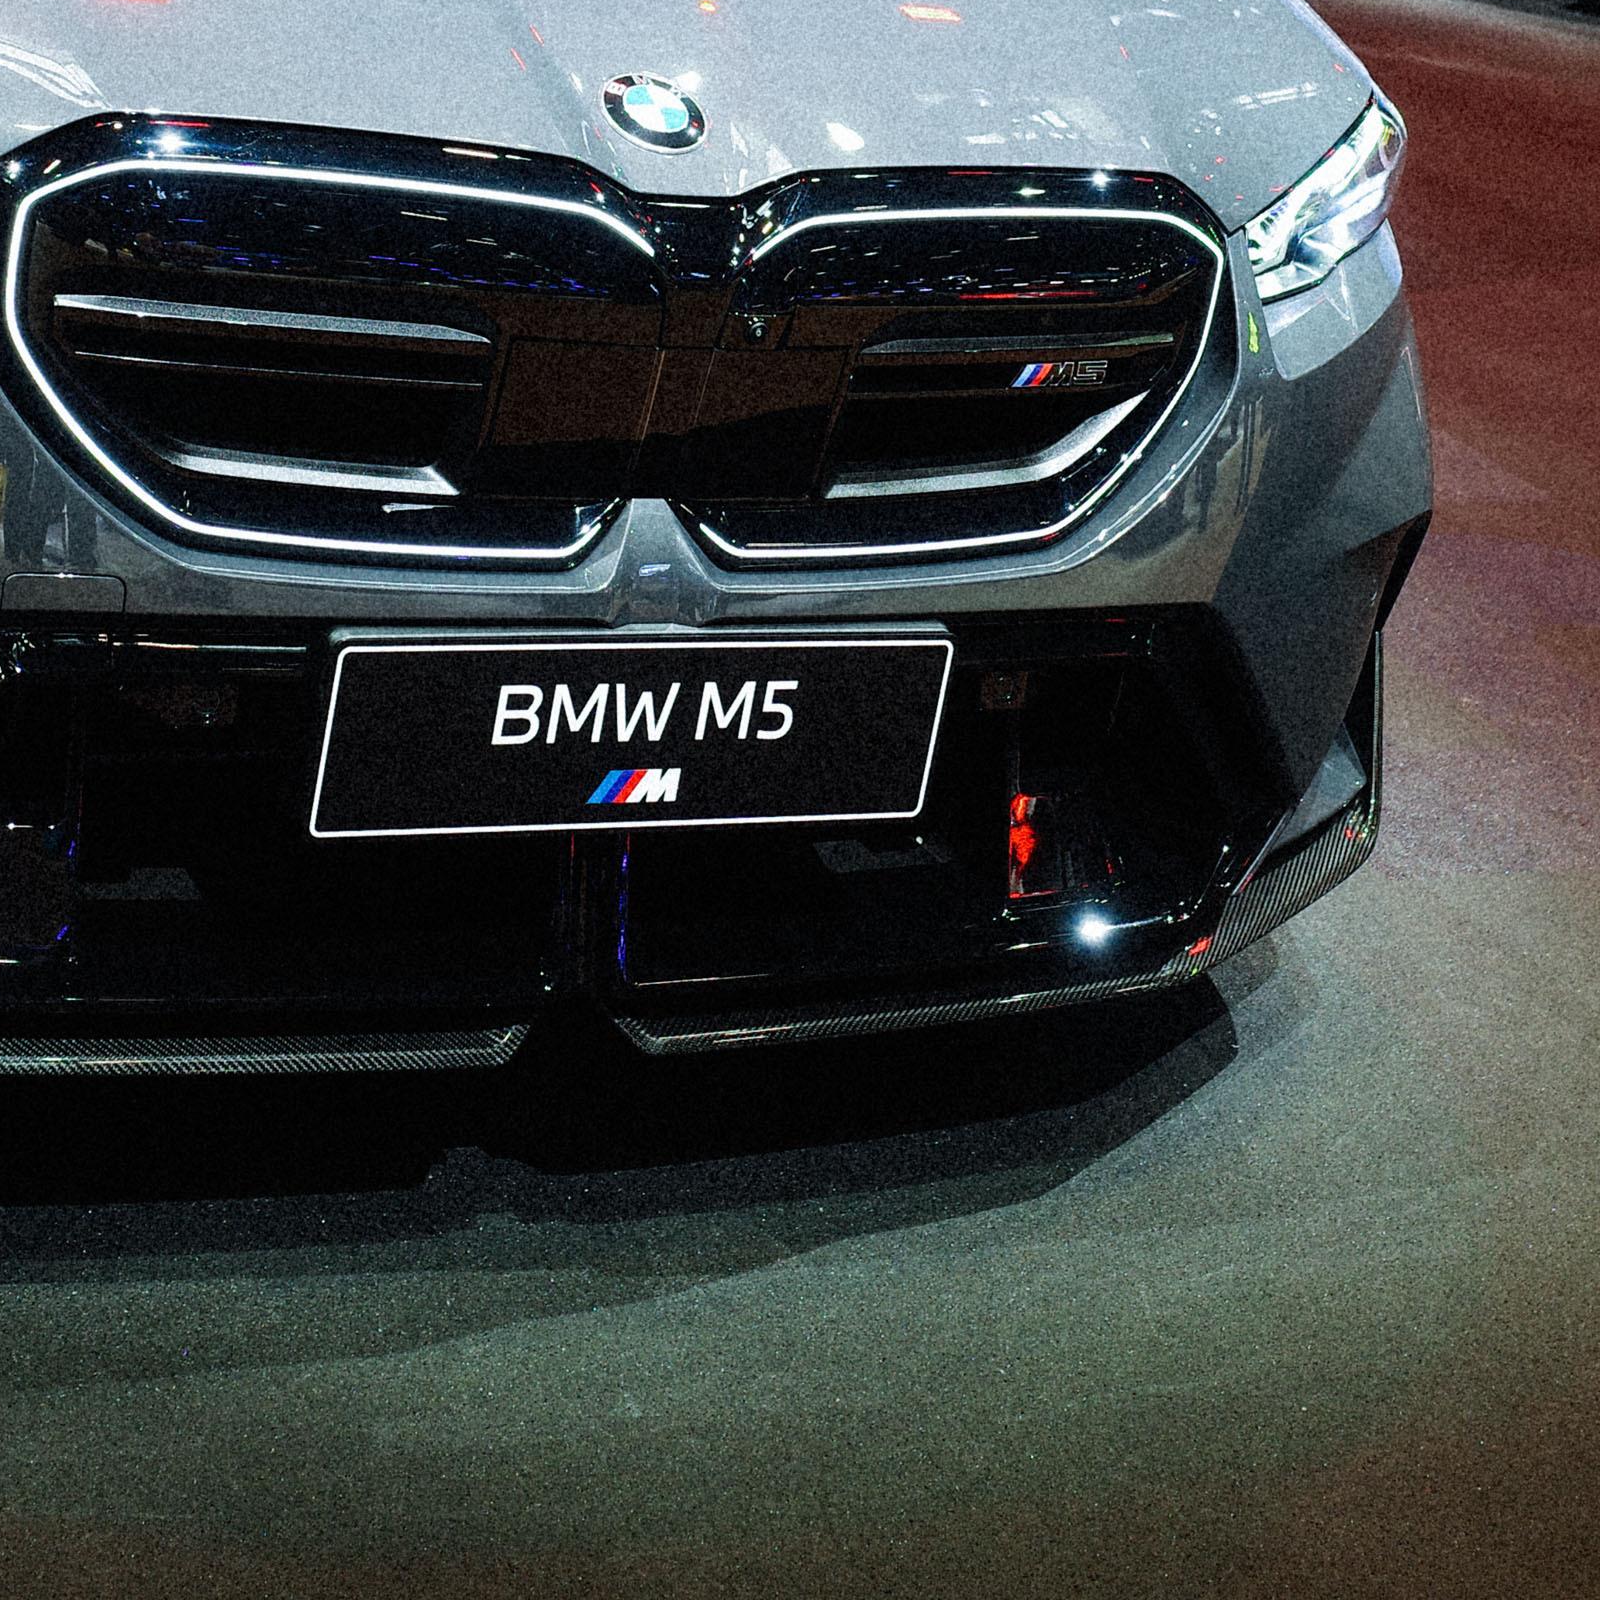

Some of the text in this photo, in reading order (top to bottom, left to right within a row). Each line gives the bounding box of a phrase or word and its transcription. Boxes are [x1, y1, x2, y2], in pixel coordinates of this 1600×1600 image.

[1041, 360, 1108, 388] M5
[491, 680, 799, 745] BMW M5
